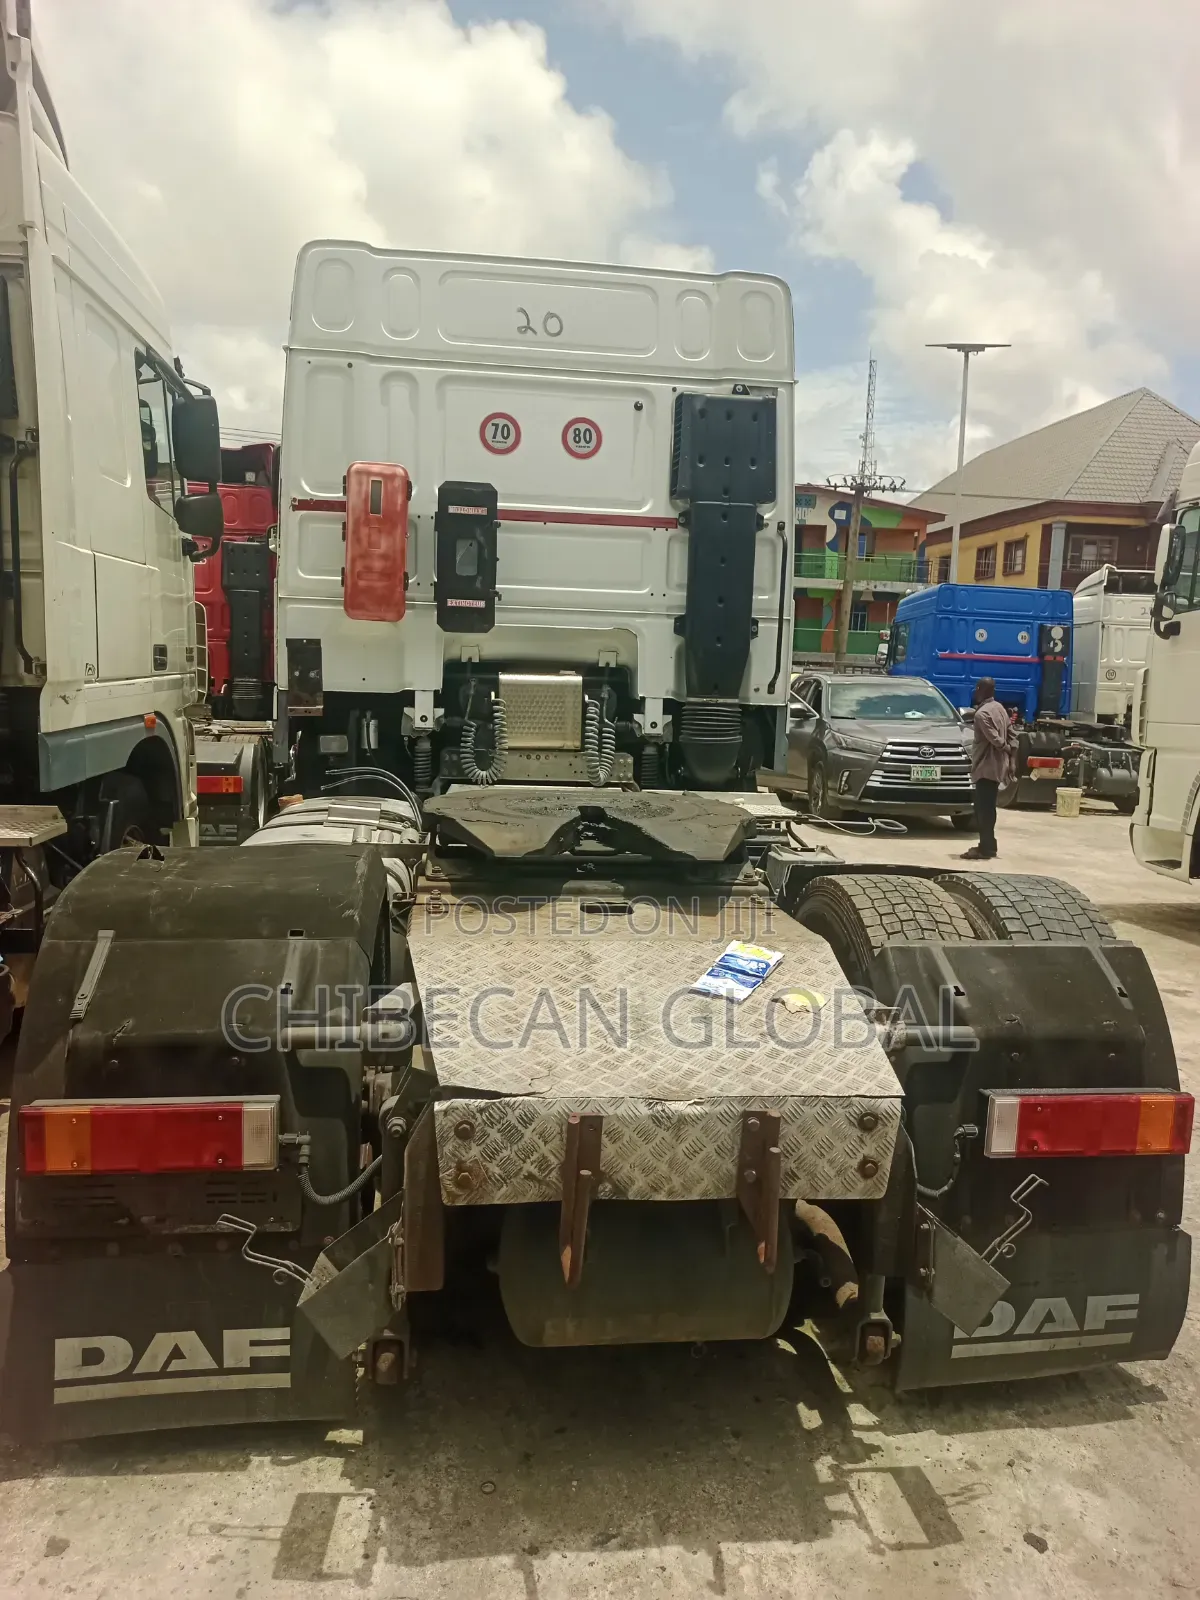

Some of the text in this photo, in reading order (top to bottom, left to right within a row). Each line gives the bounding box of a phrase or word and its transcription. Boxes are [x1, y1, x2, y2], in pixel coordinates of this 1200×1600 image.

[517, 307, 563, 337] 20
[491, 422, 510, 440] 70
[573, 427, 592, 444] 80
[200, 824, 237, 836] AF
[54, 1327, 290, 1381] DAF
